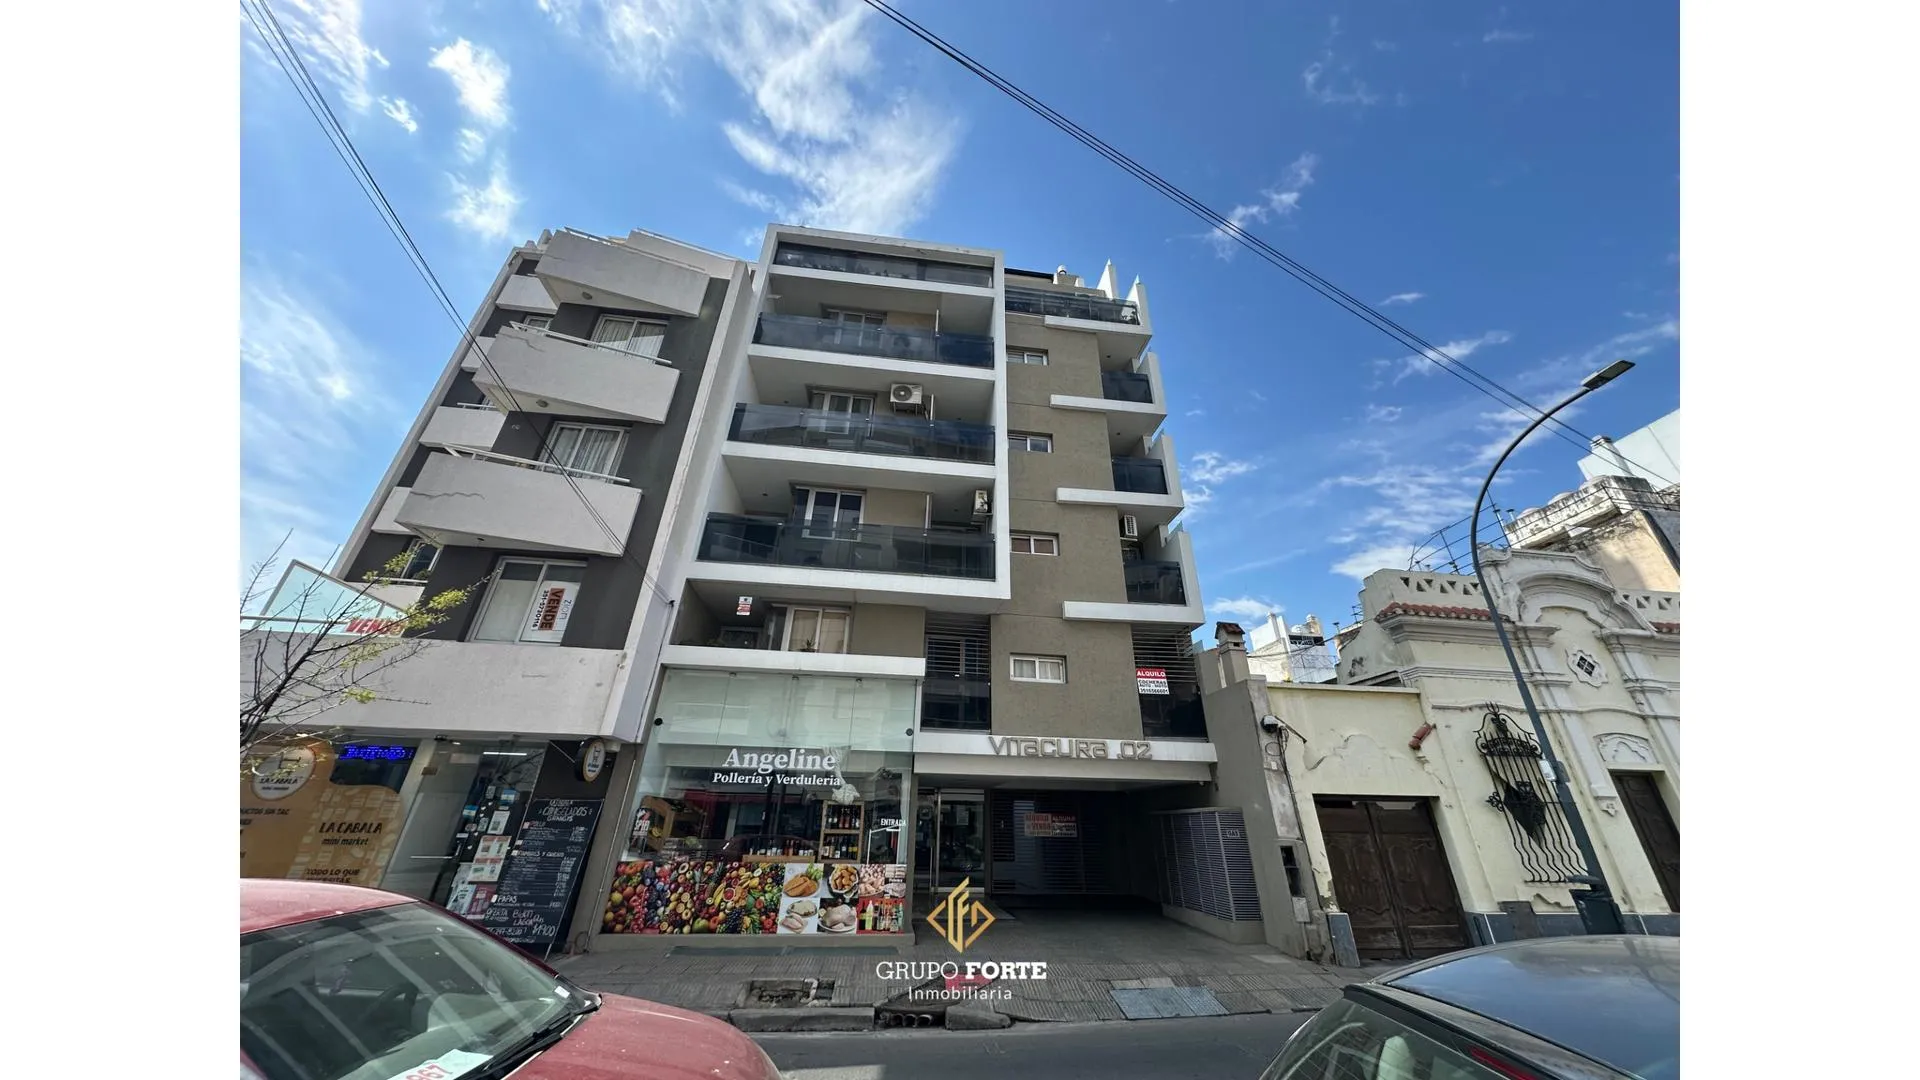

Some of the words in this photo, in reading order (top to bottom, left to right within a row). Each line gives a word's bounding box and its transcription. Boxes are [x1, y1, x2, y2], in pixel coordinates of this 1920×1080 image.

[540, 590, 564, 629] VENDE
[722, 748, 837, 774] Angeline
[712, 772, 763, 784] Pollería
[764, 776, 773, 787] y
[880, 817, 906, 827] ENTRADA
[319, 822, 335, 833] LA
[337, 822, 382, 834] CABALA
[322, 837, 341, 845] mini
[341, 837, 369, 845] market
[343, 869, 360, 877] QUE
[498, 895, 518, 903] PAPAS
